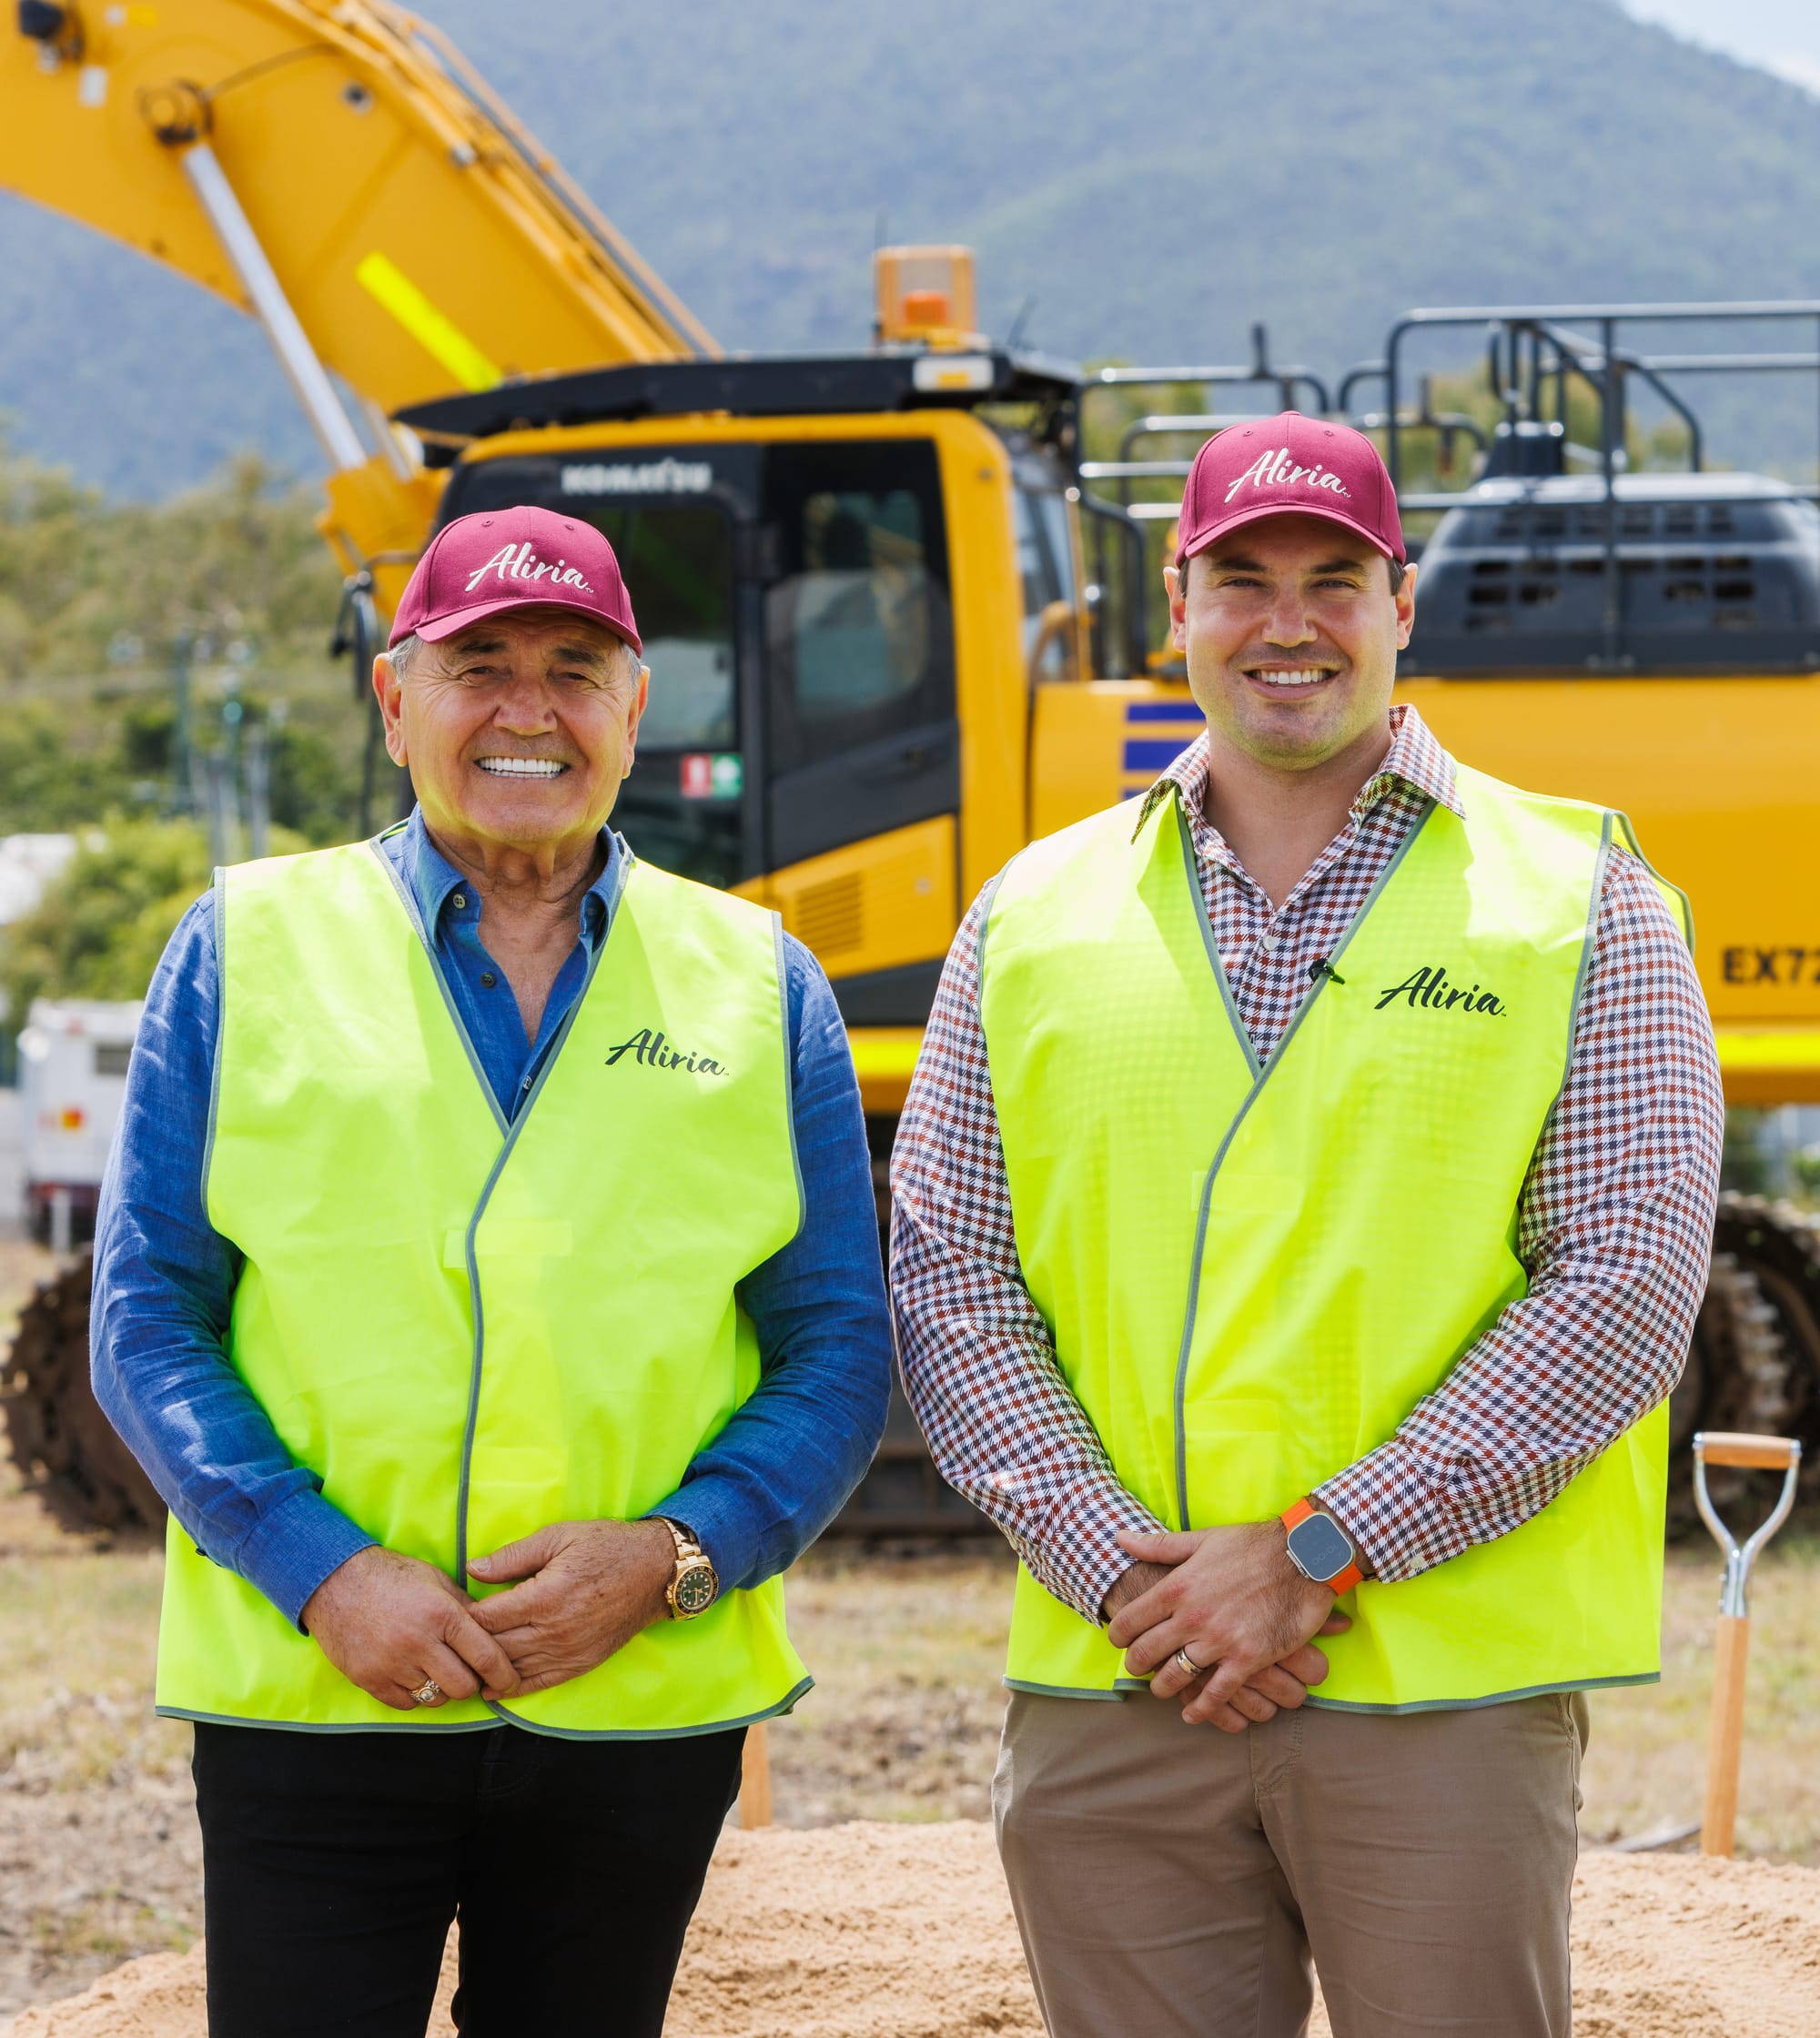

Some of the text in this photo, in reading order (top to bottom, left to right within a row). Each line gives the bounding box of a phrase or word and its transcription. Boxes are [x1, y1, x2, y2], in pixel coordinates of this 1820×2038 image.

[1224, 447, 1347, 503] Aliria
[464, 541, 590, 592] Aliria
[1373, 966, 1506, 1016] Aliria
[604, 1028, 726, 1076] Aliria
